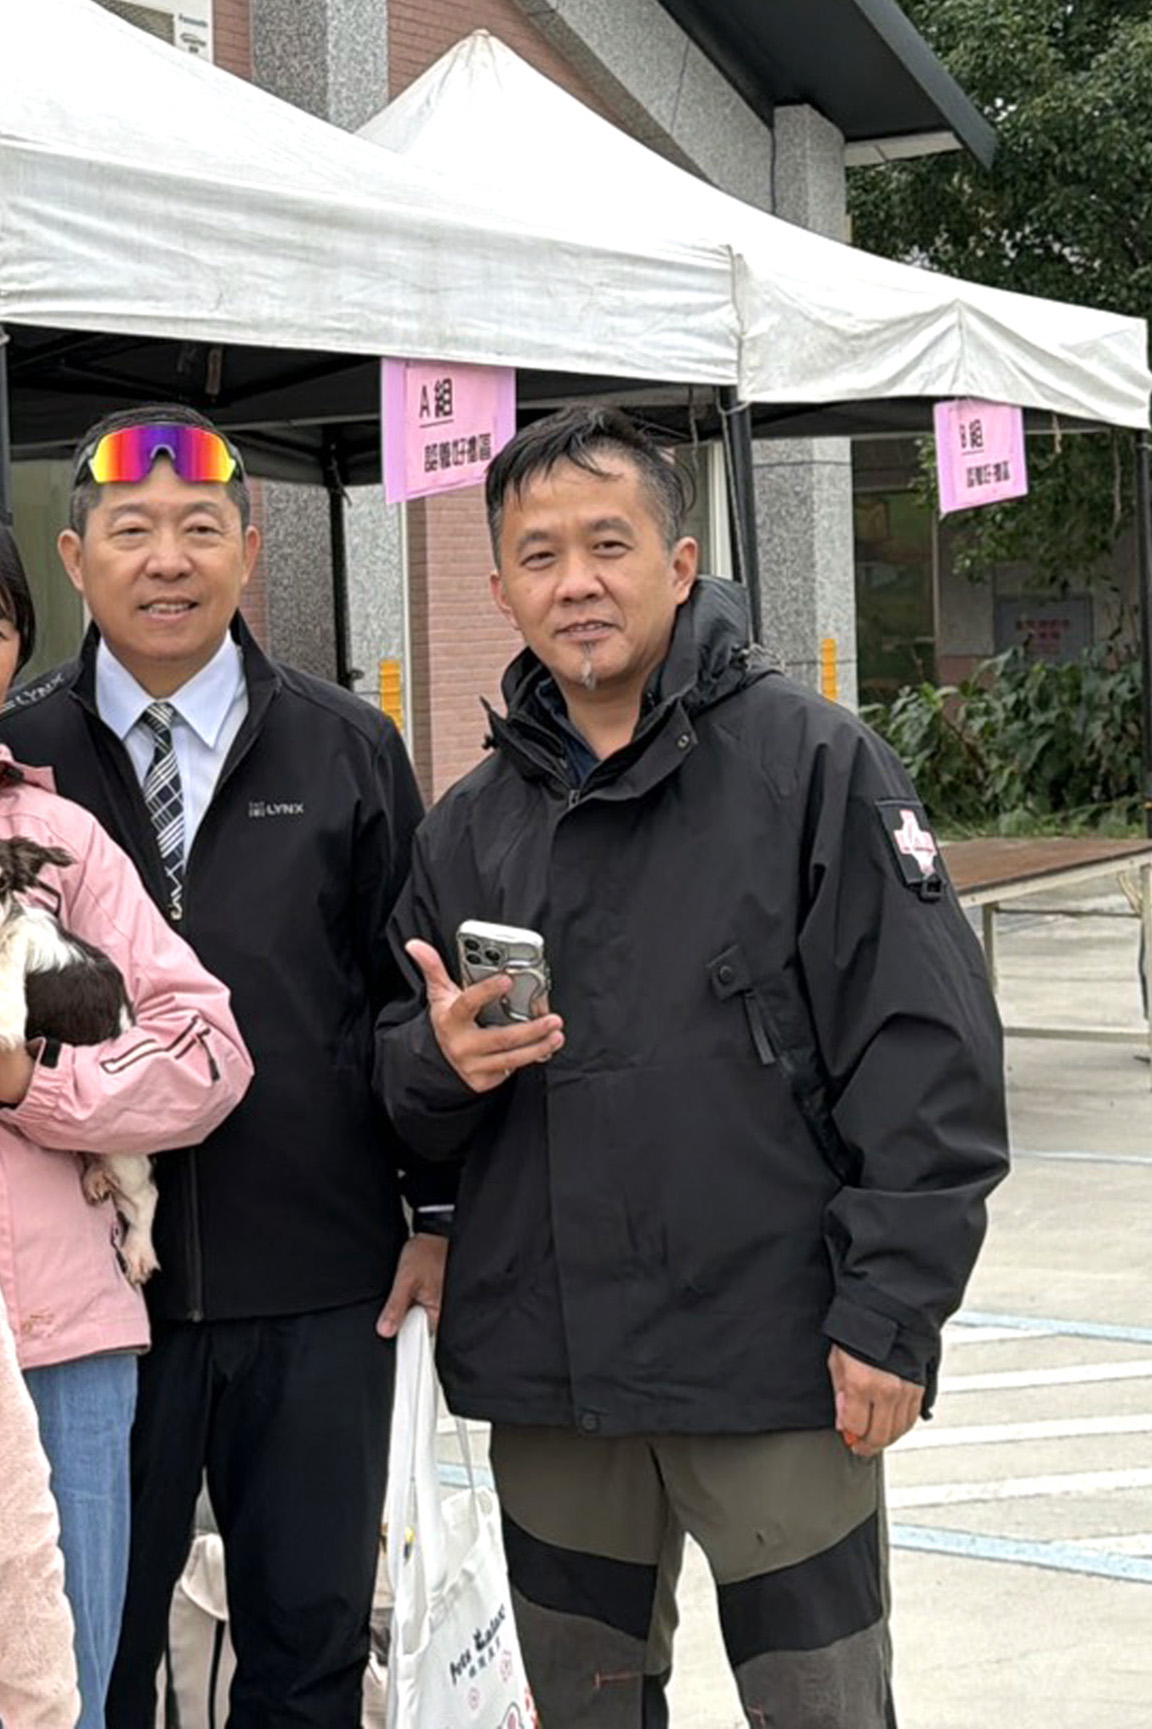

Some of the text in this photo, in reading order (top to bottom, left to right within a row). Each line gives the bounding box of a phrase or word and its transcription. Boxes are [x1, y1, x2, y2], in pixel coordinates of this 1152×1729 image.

[419, 378, 453, 418] A 組
[15, 673, 64, 706] LYNX
[266, 803, 304, 816] LYNX
